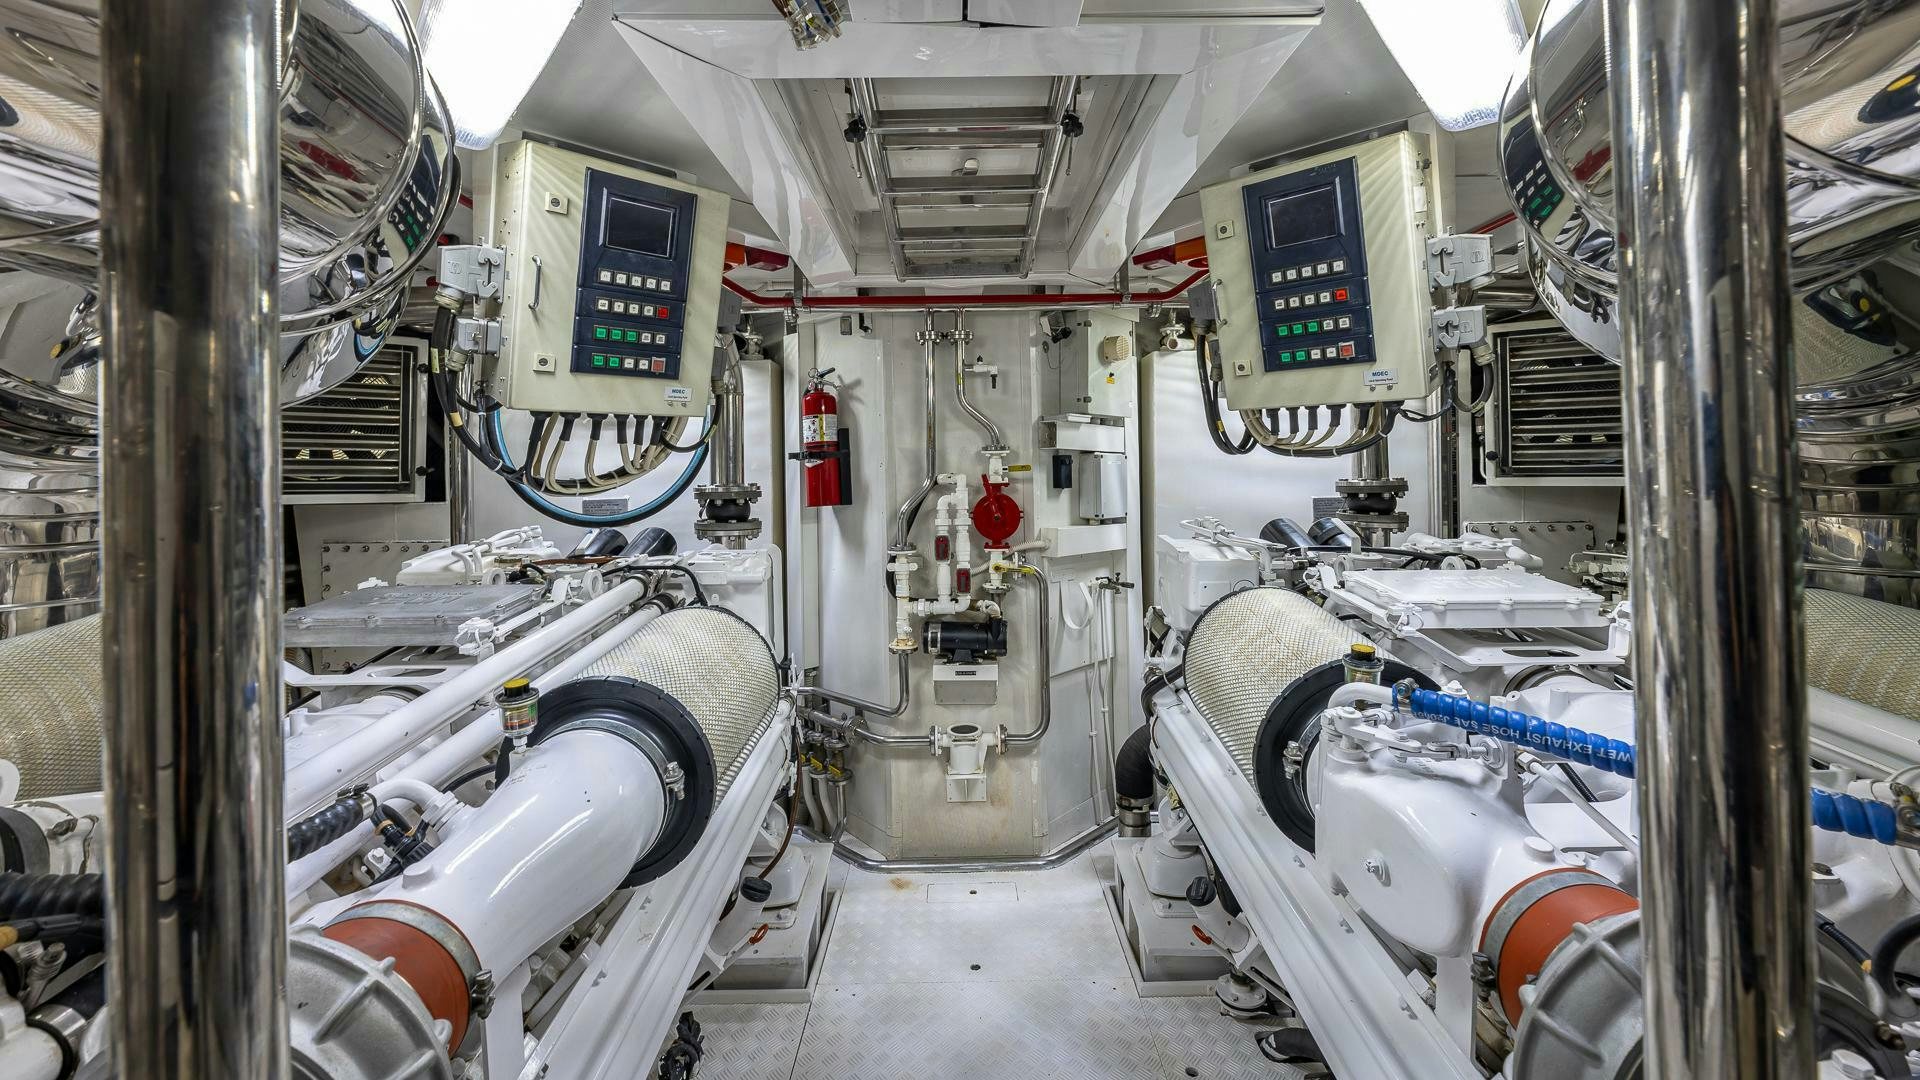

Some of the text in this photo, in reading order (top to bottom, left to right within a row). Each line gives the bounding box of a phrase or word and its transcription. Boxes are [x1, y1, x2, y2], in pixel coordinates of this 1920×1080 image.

[1454, 717, 1479, 729] SAE
[1482, 723, 1520, 739] HOSE
[1524, 732, 1593, 755] EXHAUST
[1597, 747, 1632, 762] WET
